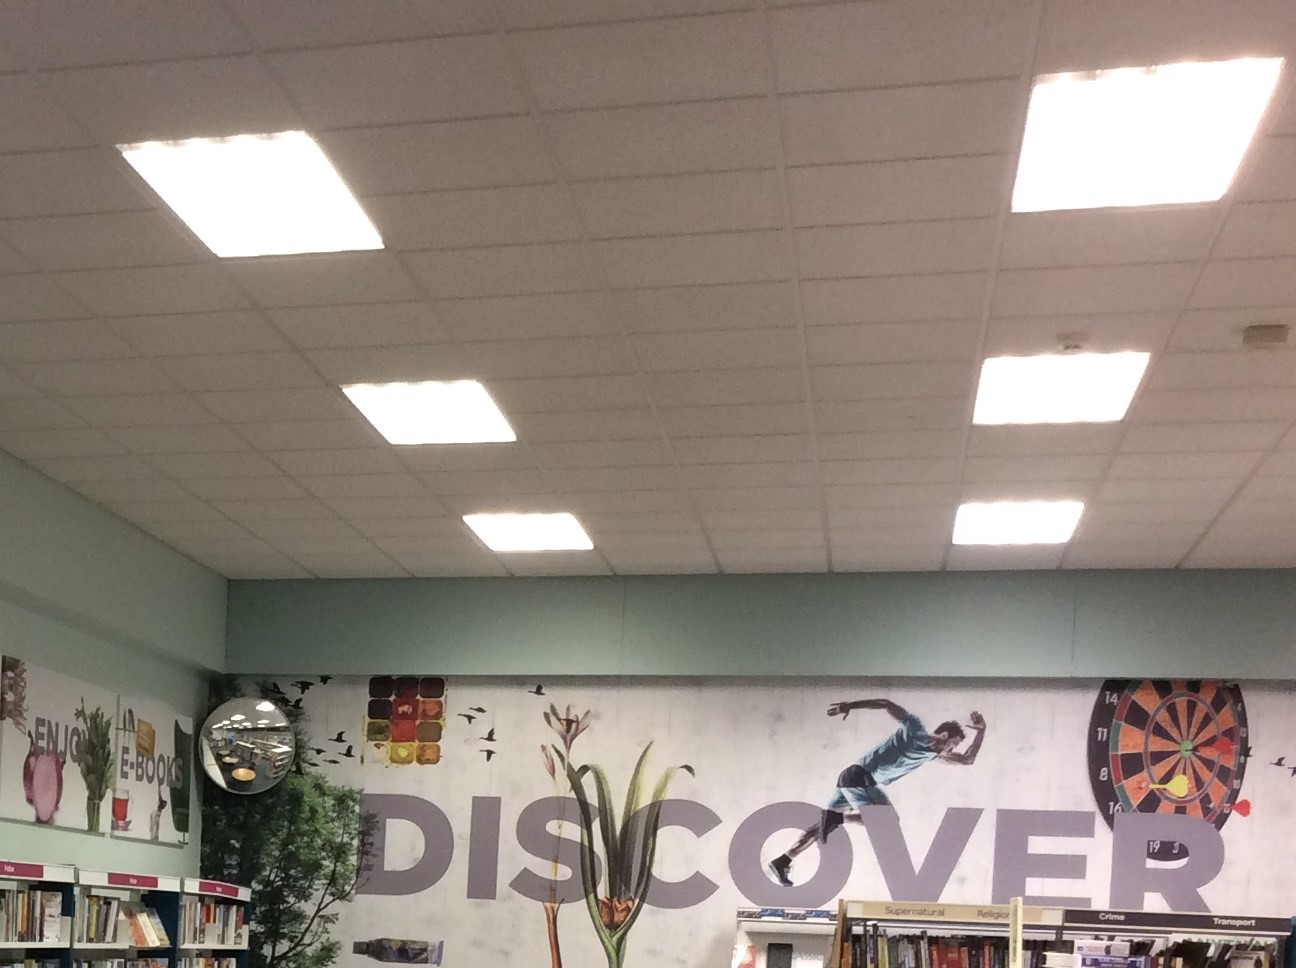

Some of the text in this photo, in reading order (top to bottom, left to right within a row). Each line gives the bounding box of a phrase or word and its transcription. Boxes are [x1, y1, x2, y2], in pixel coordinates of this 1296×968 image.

[1105, 691, 1118, 705] 14
[35, 716, 89, 764] ENJO
[1097, 728, 1108, 742] 11
[120, 745, 183, 789] E-BOOKS
[1099, 767, 1108, 781] 8
[355, 793, 1226, 912] DISCOVER
[1149, 841, 1160, 853] 19
[885, 906, 945, 917] Supernatural
[1099, 912, 1125, 921] Crime
[1213, 917, 1256, 928] Transport
